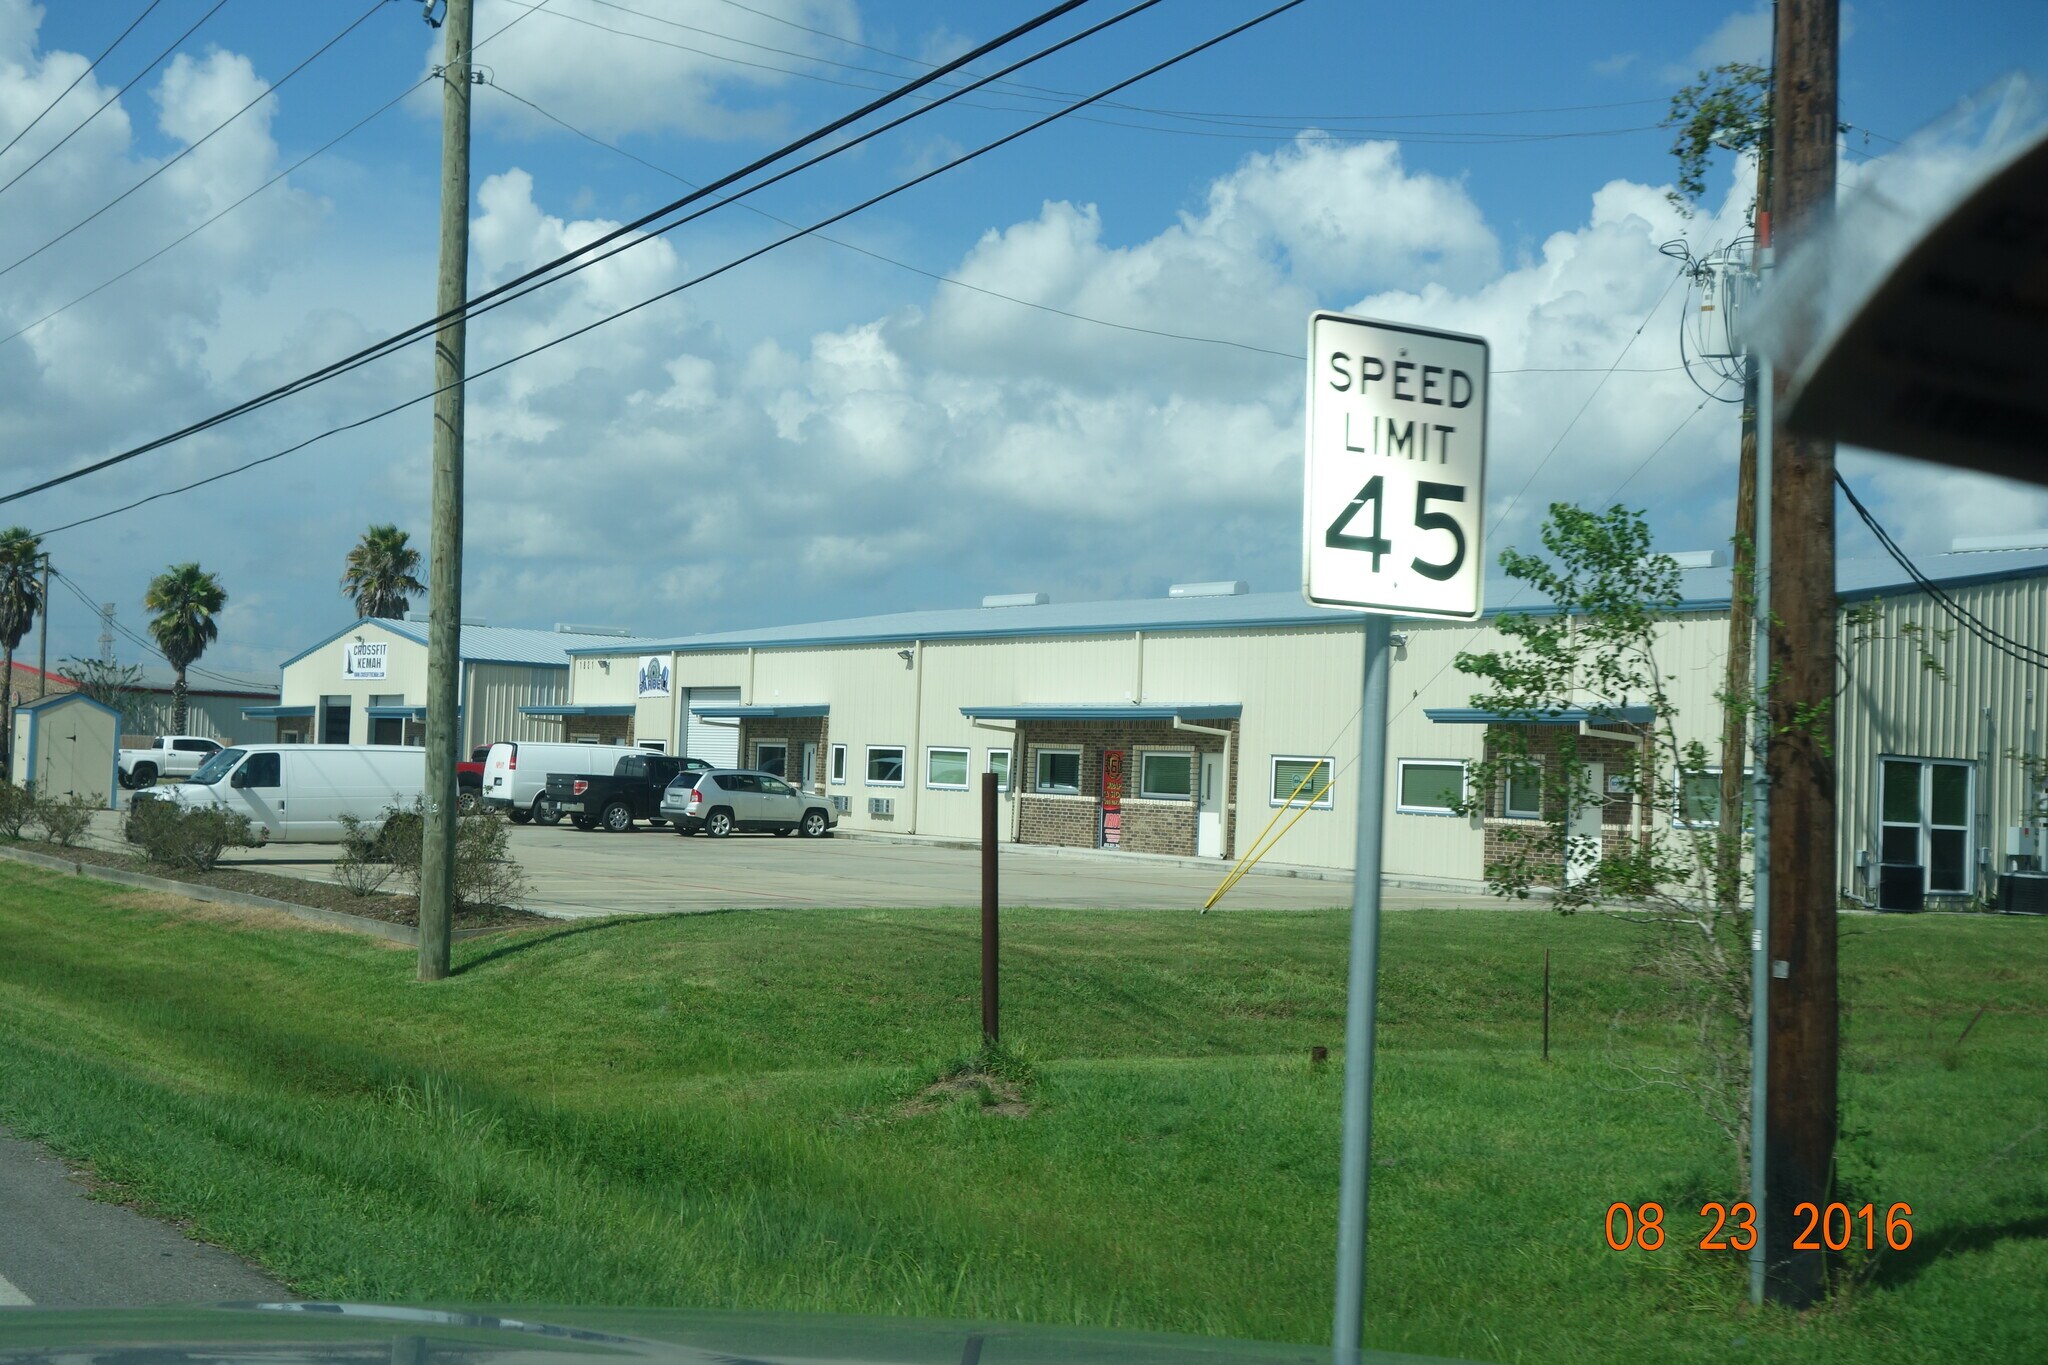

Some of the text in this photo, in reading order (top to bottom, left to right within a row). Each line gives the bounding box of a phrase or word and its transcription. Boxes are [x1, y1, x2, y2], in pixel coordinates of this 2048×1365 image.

[1330, 351, 1473, 409] SPEED
[1346, 412, 1455, 464] LIMIT
[1325, 475, 1466, 581] 45
[353, 644, 387, 655] CROSSFIT
[357, 658, 382, 668] KEMAH
